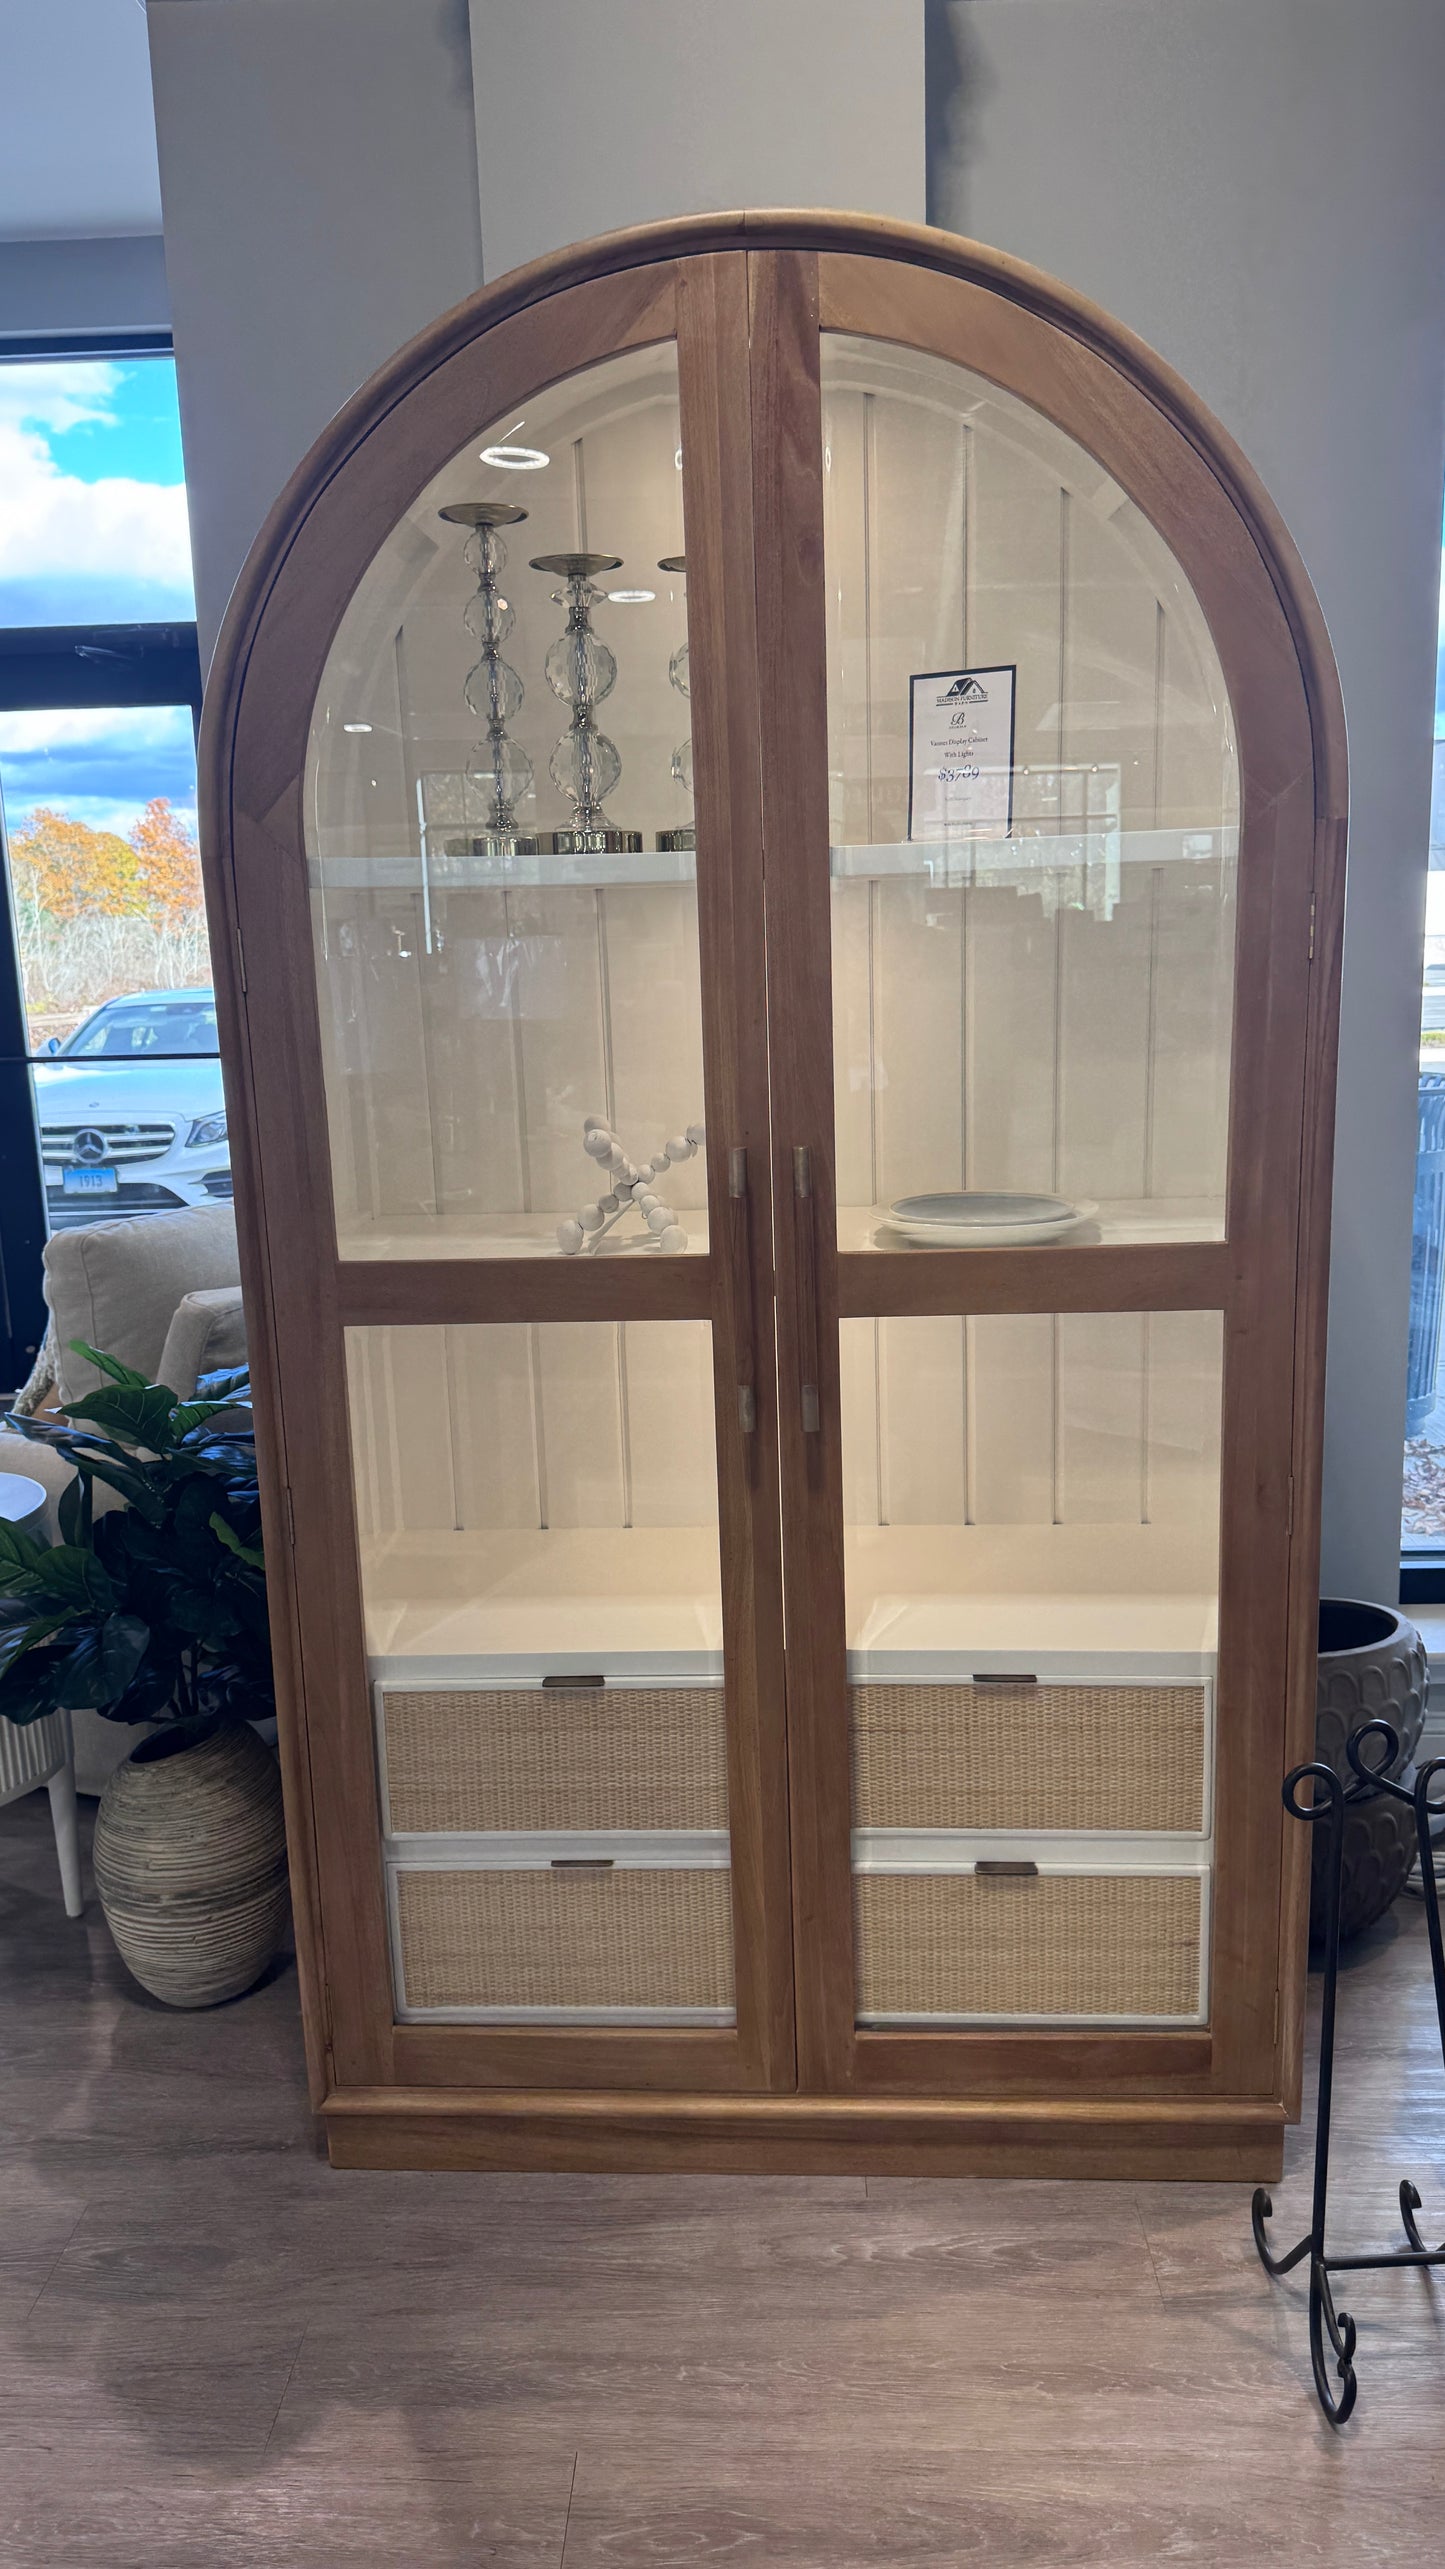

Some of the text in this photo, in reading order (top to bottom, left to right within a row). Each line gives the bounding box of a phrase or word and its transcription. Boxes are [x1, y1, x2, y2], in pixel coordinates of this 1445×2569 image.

[960, 694, 987, 702] FURNITURE
[948, 738, 967, 746] Display
[968, 736, 988, 744] Cabinet
[958, 751, 974, 759] Lights
